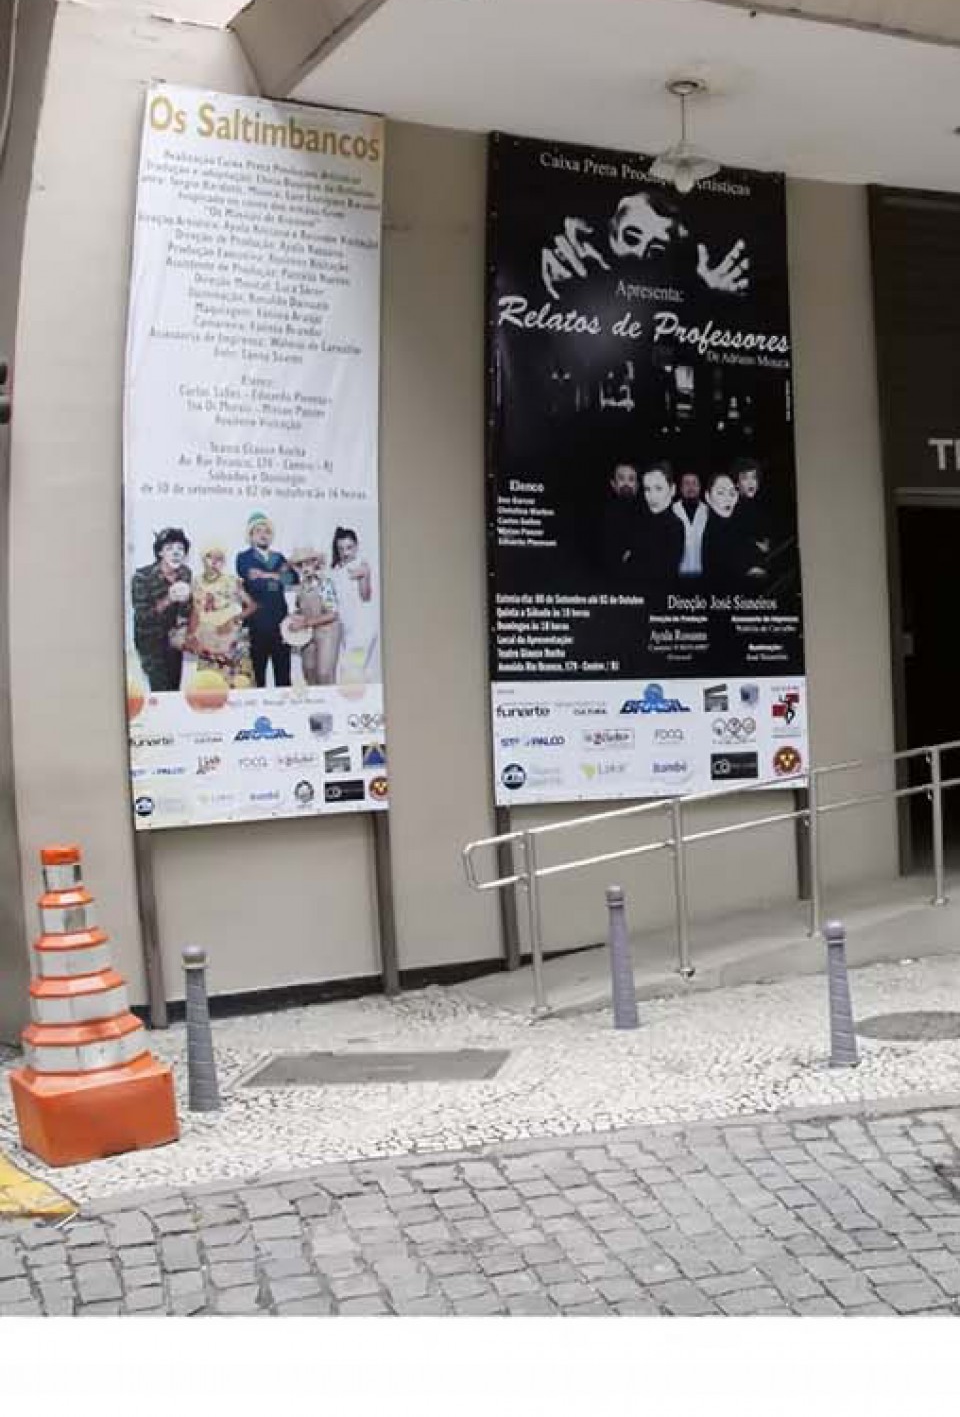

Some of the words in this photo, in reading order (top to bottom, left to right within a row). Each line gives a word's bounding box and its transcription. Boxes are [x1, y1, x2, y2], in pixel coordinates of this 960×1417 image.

[150, 95, 187, 134] Os
[197, 102, 380, 162] Saltimbancos
[540, 153, 580, 172] Caixa
[583, 160, 617, 177] Preta
[615, 280, 685, 303] Apresenta:
[498, 296, 601, 336] Relatos
[612, 313, 642, 339] de
[653, 311, 789, 353] Professores
[509, 479, 545, 493] Elenco
[710, 594, 732, 610] José
